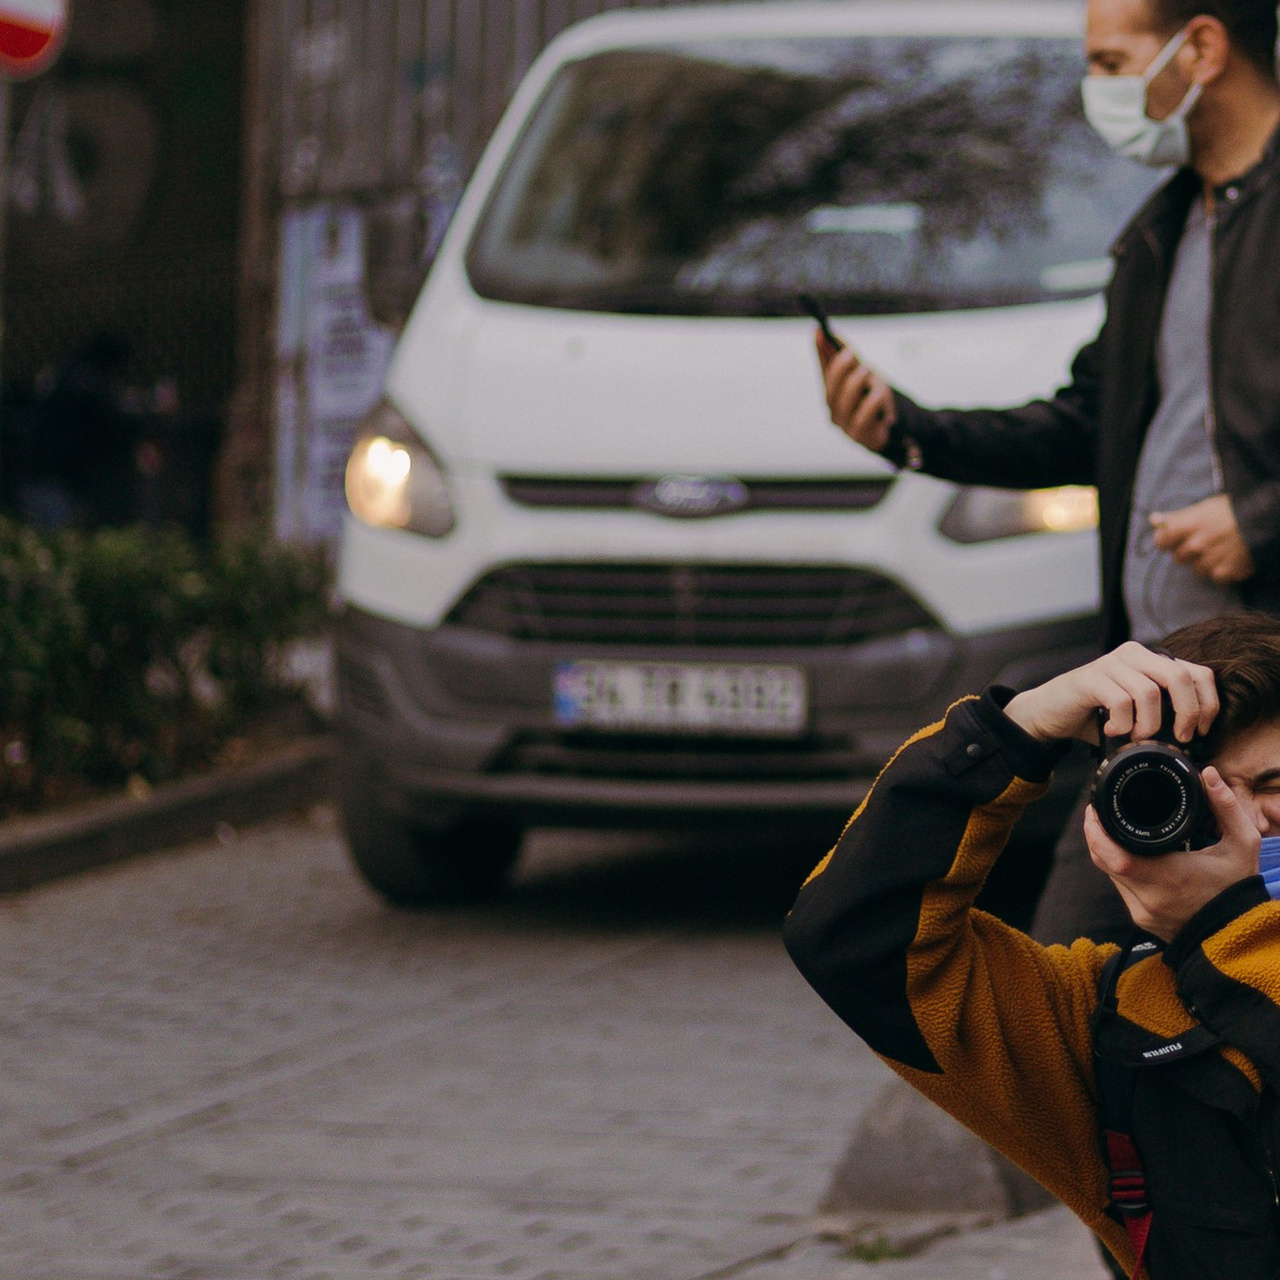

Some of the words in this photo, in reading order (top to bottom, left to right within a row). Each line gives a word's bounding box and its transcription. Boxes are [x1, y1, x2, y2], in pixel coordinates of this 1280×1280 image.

[1160, 764, 1182, 784] FUJINON
[1175, 786, 1186, 822] ASPHERICAL
[1161, 822, 1176, 834] LENS
[1142, 1042, 1183, 1058] FUJIFILM
